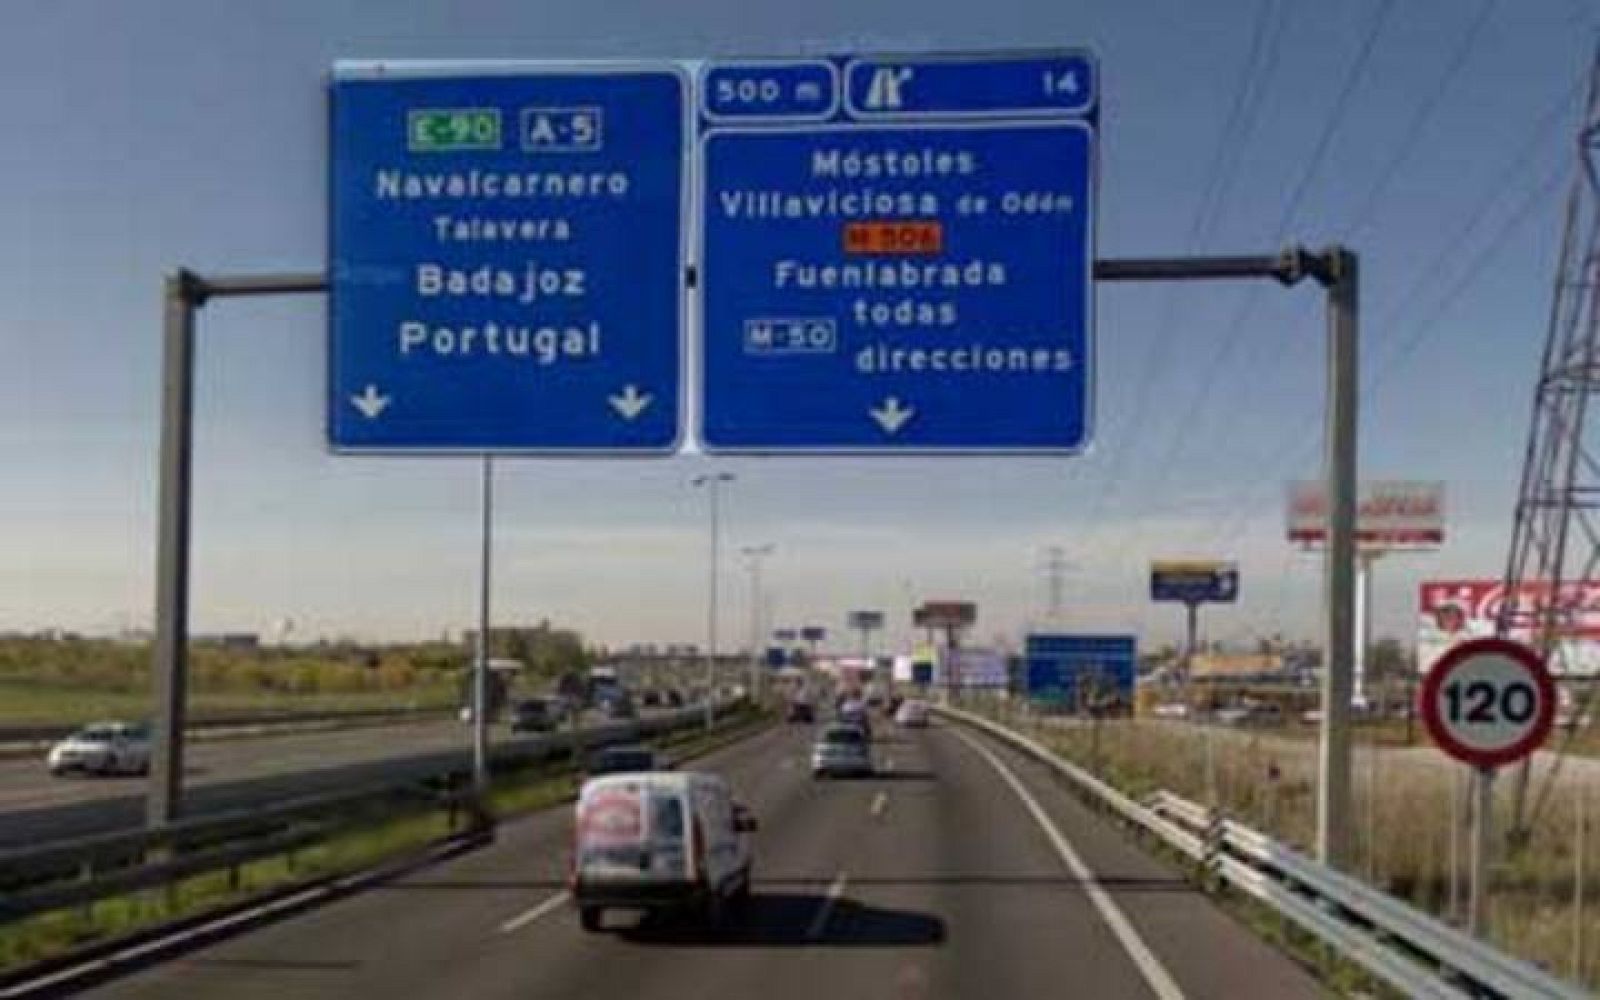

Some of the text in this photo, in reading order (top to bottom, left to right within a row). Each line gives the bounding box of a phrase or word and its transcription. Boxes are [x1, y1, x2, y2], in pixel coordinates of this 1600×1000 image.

[715, 80, 781, 102] 500
[1044, 71, 1078, 95] 14
[414, 114, 494, 142] E-90
[530, 114, 594, 145] A-5
[813, 149, 974, 176] Móstoles
[376, 169, 628, 198] Navalcarnero
[720, 189, 936, 217] Villaviciosa
[435, 216, 570, 240] Talavera
[417, 262, 585, 302] Badajoz
[775, 260, 1006, 287] Fuenlabrada
[853, 299, 956, 325] todas
[399, 322, 599, 364] Portugal
[749, 323, 831, 347] M-50
[856, 344, 1072, 371] direcciones
[1444, 682, 1536, 723] 120
